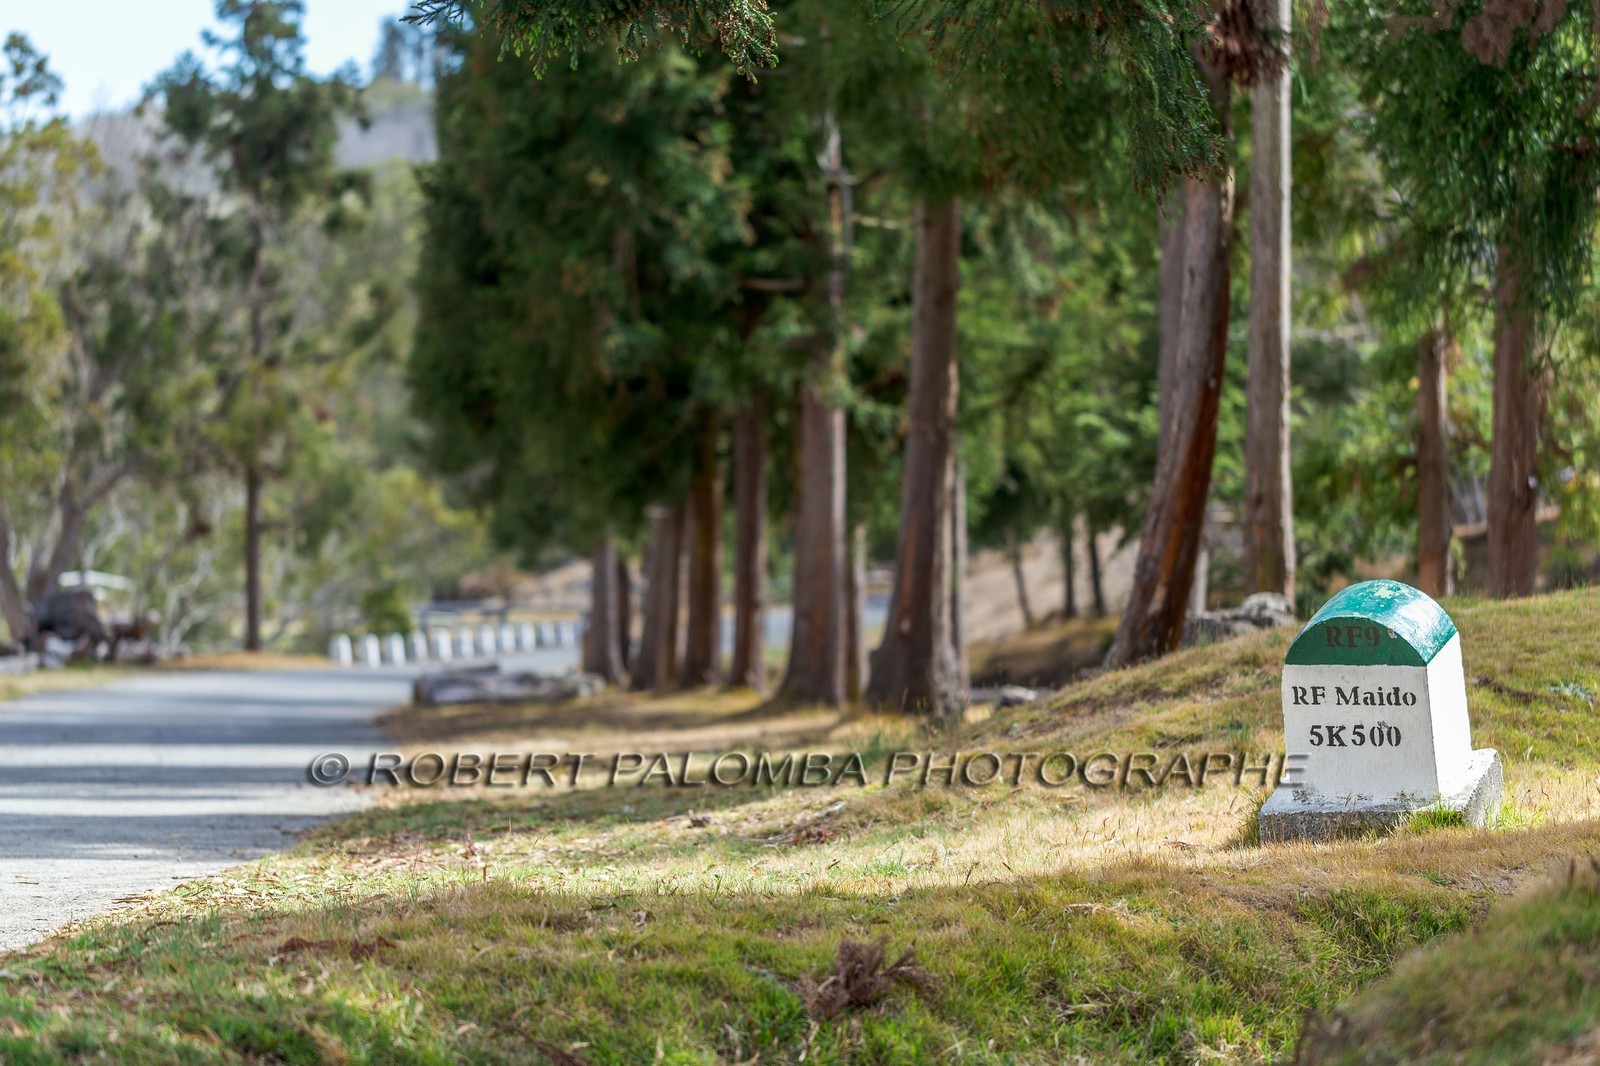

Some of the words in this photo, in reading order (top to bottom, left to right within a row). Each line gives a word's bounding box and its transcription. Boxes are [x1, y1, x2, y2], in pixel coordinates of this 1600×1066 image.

[1325, 625, 1380, 648] RF9
[1291, 686, 1326, 706] RF
[1334, 686, 1417, 707] Maido
[1309, 724, 1402, 748] 5K500
